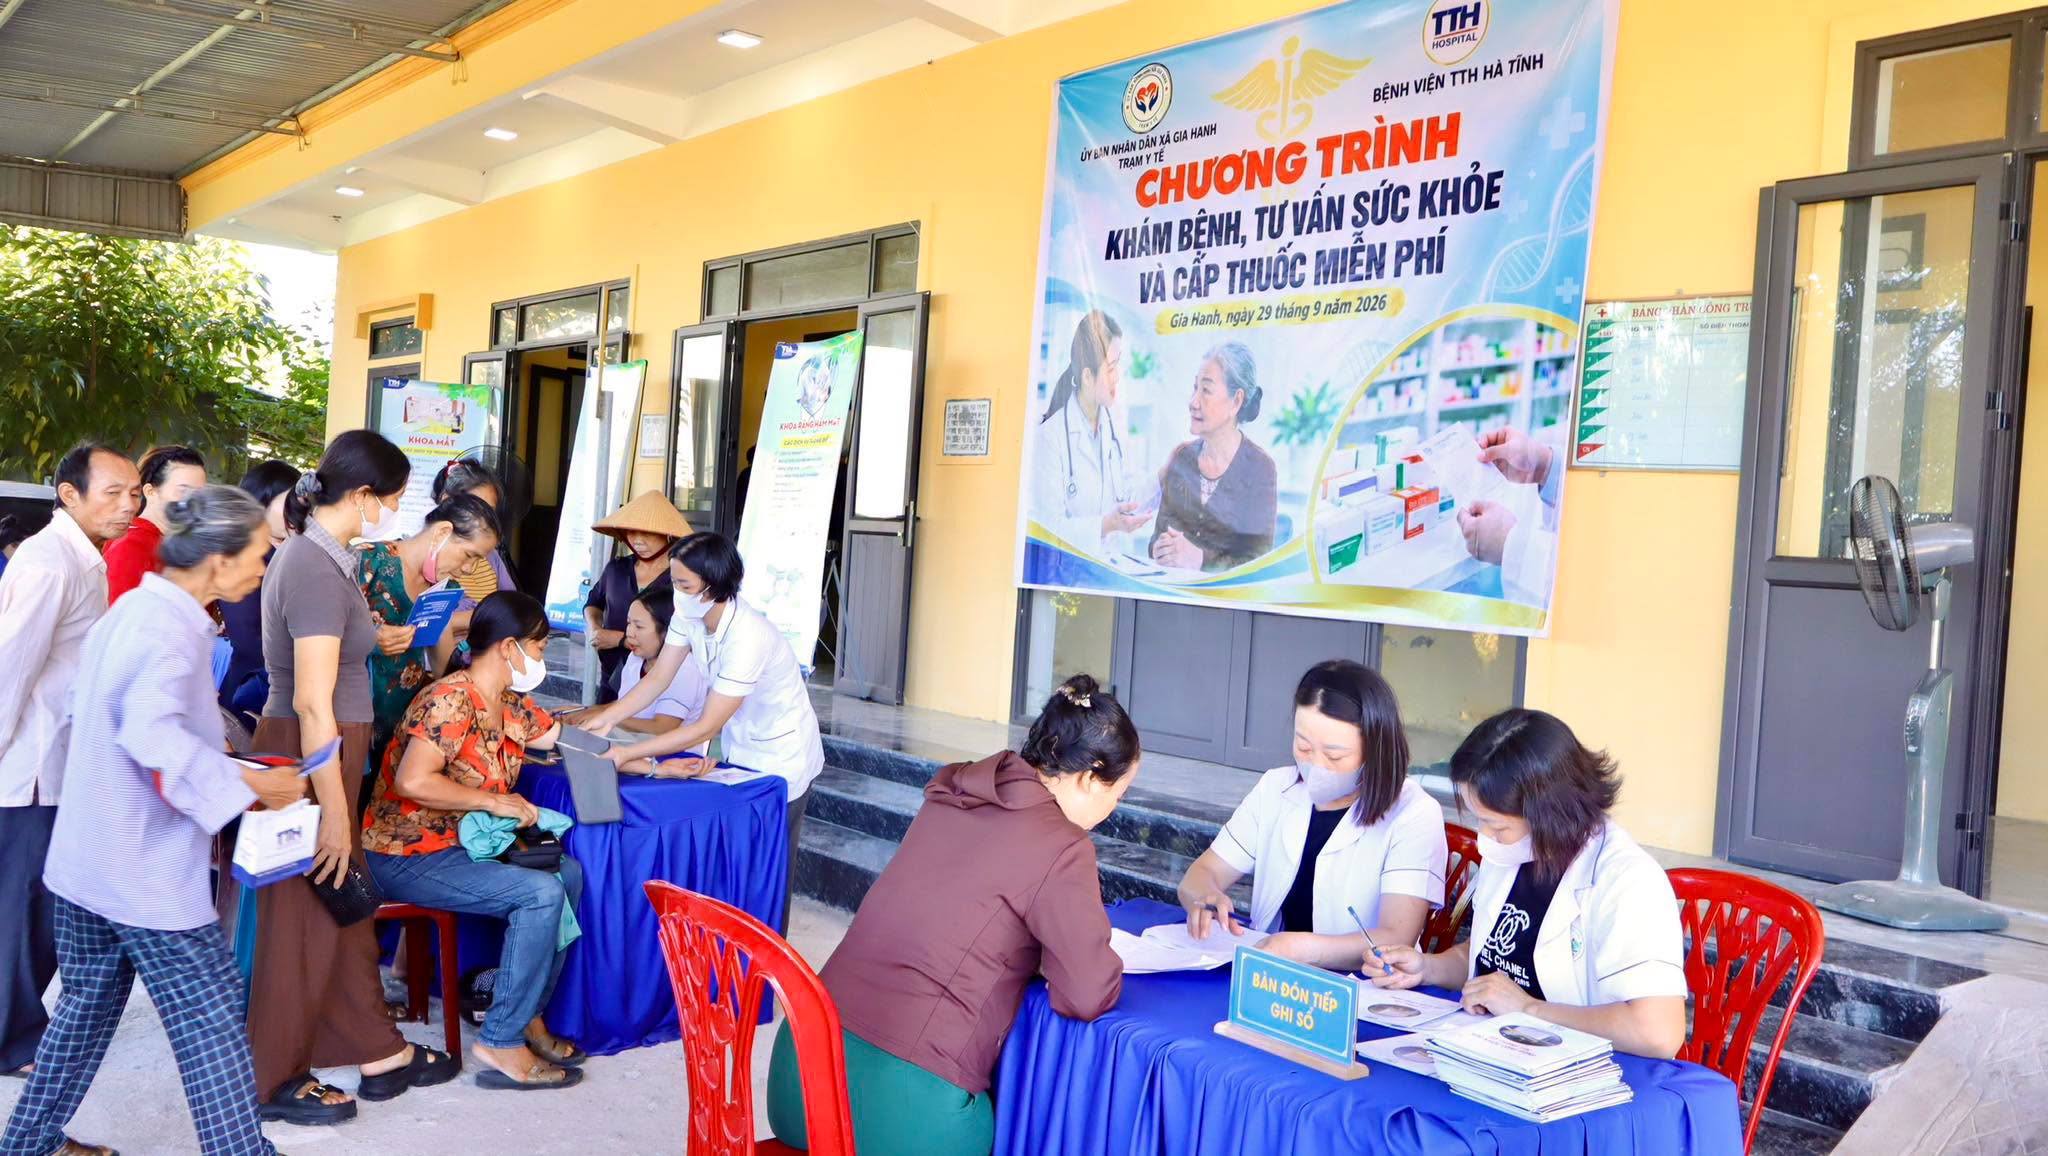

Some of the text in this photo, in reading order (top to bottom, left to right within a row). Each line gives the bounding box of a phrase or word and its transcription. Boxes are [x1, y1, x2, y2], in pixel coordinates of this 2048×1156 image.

[1432, 2, 1481, 36] TTH
[1432, 32, 1477, 49] HOSPITAL
[1373, 53, 1544, 104] BỆNH VIỆN TTH HÀ TĨNH
[1080, 123, 1217, 162] ỦY BAN NHÂN DÂN XÃ GIA HANH
[1119, 146, 1166, 170] TRẠM Y TẾ
[1136, 112, 1461, 209] CHƯƠNG TRÌNH
[1105, 161, 1505, 261] KHÁM BỆNH, TƯ VẤN SỨC KHỎE
[1139, 226, 1449, 304] VÀ CẤP THUỐC MIỄN PHÍ
[1170, 294, 1388, 328] Gia Hanh, ngày 29 tháng 9 năm 2026
[1666, 302, 1696, 316] HÂN
[1734, 302, 1752, 313] TR
[408, 436, 433, 445] KHOA
[1494, 955, 1530, 980] CHANEL
[1252, 970, 1339, 1013] BÀN ĐÓN TIẾP
[1270, 1002, 1293, 1023] GHI
